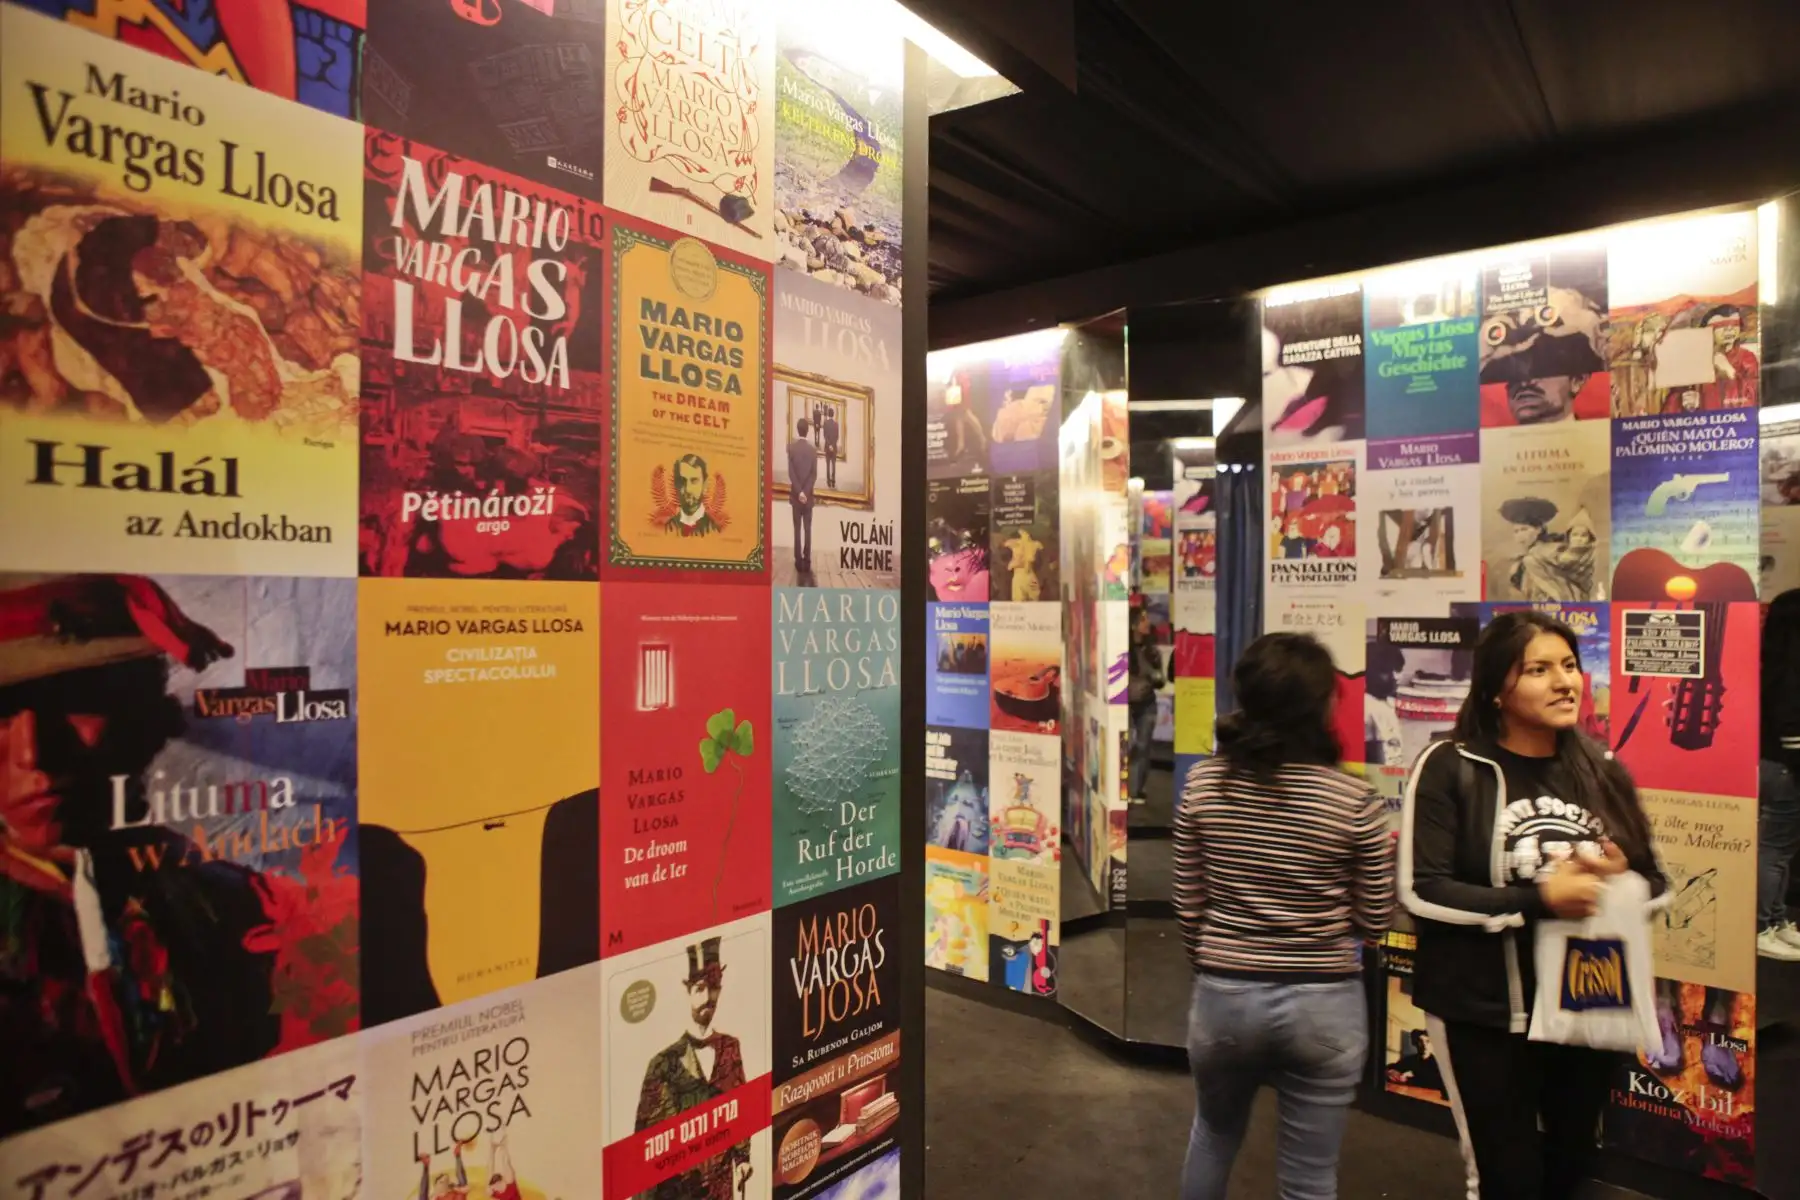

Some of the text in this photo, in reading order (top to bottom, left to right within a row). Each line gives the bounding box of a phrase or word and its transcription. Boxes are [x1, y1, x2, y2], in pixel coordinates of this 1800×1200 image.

[649, 10, 735, 74] CELT
[84, 62, 206, 127] Mario
[652, 60, 731, 117] MARIO
[783, 76, 824, 111] Mario
[826, 99, 864, 132] Vargas
[643, 82, 738, 145] VARGAS
[26, 81, 340, 223] Vargas Llosa
[652, 114, 729, 167] LLOSA
[391, 155, 569, 252] MARIO
[394, 236, 567, 321] VARGAS
[640, 296, 744, 343] MARIO
[780, 293, 872, 335] MARIO VARGAS
[393, 280, 571, 390] LLOSA
[640, 324, 744, 369] VARGAS
[803, 316, 890, 371] LLOSA
[1324, 345, 1361, 360] CATTIVA
[640, 353, 742, 396] LLOSA
[1378, 355, 1467, 377] Geschichte
[652, 391, 730, 414] THE DREAM
[652, 408, 730, 430] OF THE CELT
[1622, 412, 1747, 431] MARIO VARGAS LLOSA
[1683, 426, 1724, 441] MATÓ
[1726, 428, 1737, 438] A
[1378, 453, 1462, 469] VARGAS LLOSA
[1400, 444, 1439, 455] MARIO
[1616, 437, 1756, 457] PALOMINO MOLERO?
[26, 438, 243, 498] Halál
[402, 486, 555, 522] Pětinároží
[126, 509, 332, 544] az Andokban
[476, 517, 510, 535] argo
[840, 520, 894, 546] VOLÁNÍ
[840, 547, 894, 573] KMENE
[778, 592, 898, 624] MARIO
[385, 618, 584, 637] MARIO VARGAS LLOSA
[780, 626, 898, 655] VARGAS
[1390, 622, 1419, 633] MARIO
[1390, 631, 1461, 643] VARGAS LLOSA
[249, 670, 307, 690] Mario
[424, 664, 557, 684] SPECTACOLULUI
[776, 656, 898, 695] LLOSA
[197, 690, 347, 724] Vargas Llosa
[628, 766, 683, 788] MARIO
[109, 770, 296, 831] Lituma
[627, 789, 685, 811] VARGAS
[840, 800, 876, 827] Der
[1535, 796, 1605, 835] SOCIA
[1663, 797, 1704, 808] VARGAS
[1706, 800, 1741, 813] LLOSA
[633, 814, 679, 835] LLOSA
[1664, 816, 1689, 830] ölte
[1695, 821, 1725, 838] meg
[127, 843, 167, 872] w
[624, 839, 688, 864] De droom
[798, 826, 874, 864] Ruf der
[1684, 833, 1751, 853] Molerót?
[624, 861, 688, 890] van de Ier
[836, 845, 896, 882] Horde
[798, 903, 876, 961] MARIO
[790, 928, 886, 999] VARGAS
[411, 998, 525, 1044] PREMIUL NOBEL
[802, 970, 881, 1040] LJOSA
[412, 1011, 526, 1057] PENTRU LITERATURĂ
[807, 1036, 849, 1063] RUBENOM
[851, 1021, 883, 1042] GALJOM
[1710, 1032, 1747, 1053] Llosa
[411, 1036, 530, 1101] MARIO
[780, 1042, 894, 1108] Razgovori u Prinstonu
[411, 1064, 530, 1125] VARGAS
[1610, 1089, 1682, 1121] Palomina
[1628, 1071, 1733, 1116] Kto zabił
[16, 1074, 356, 1200] アンデスのリトゥーマ
[414, 1093, 532, 1164] LLOSA
[644, 1098, 738, 1162] מריו ורגס יוסה
